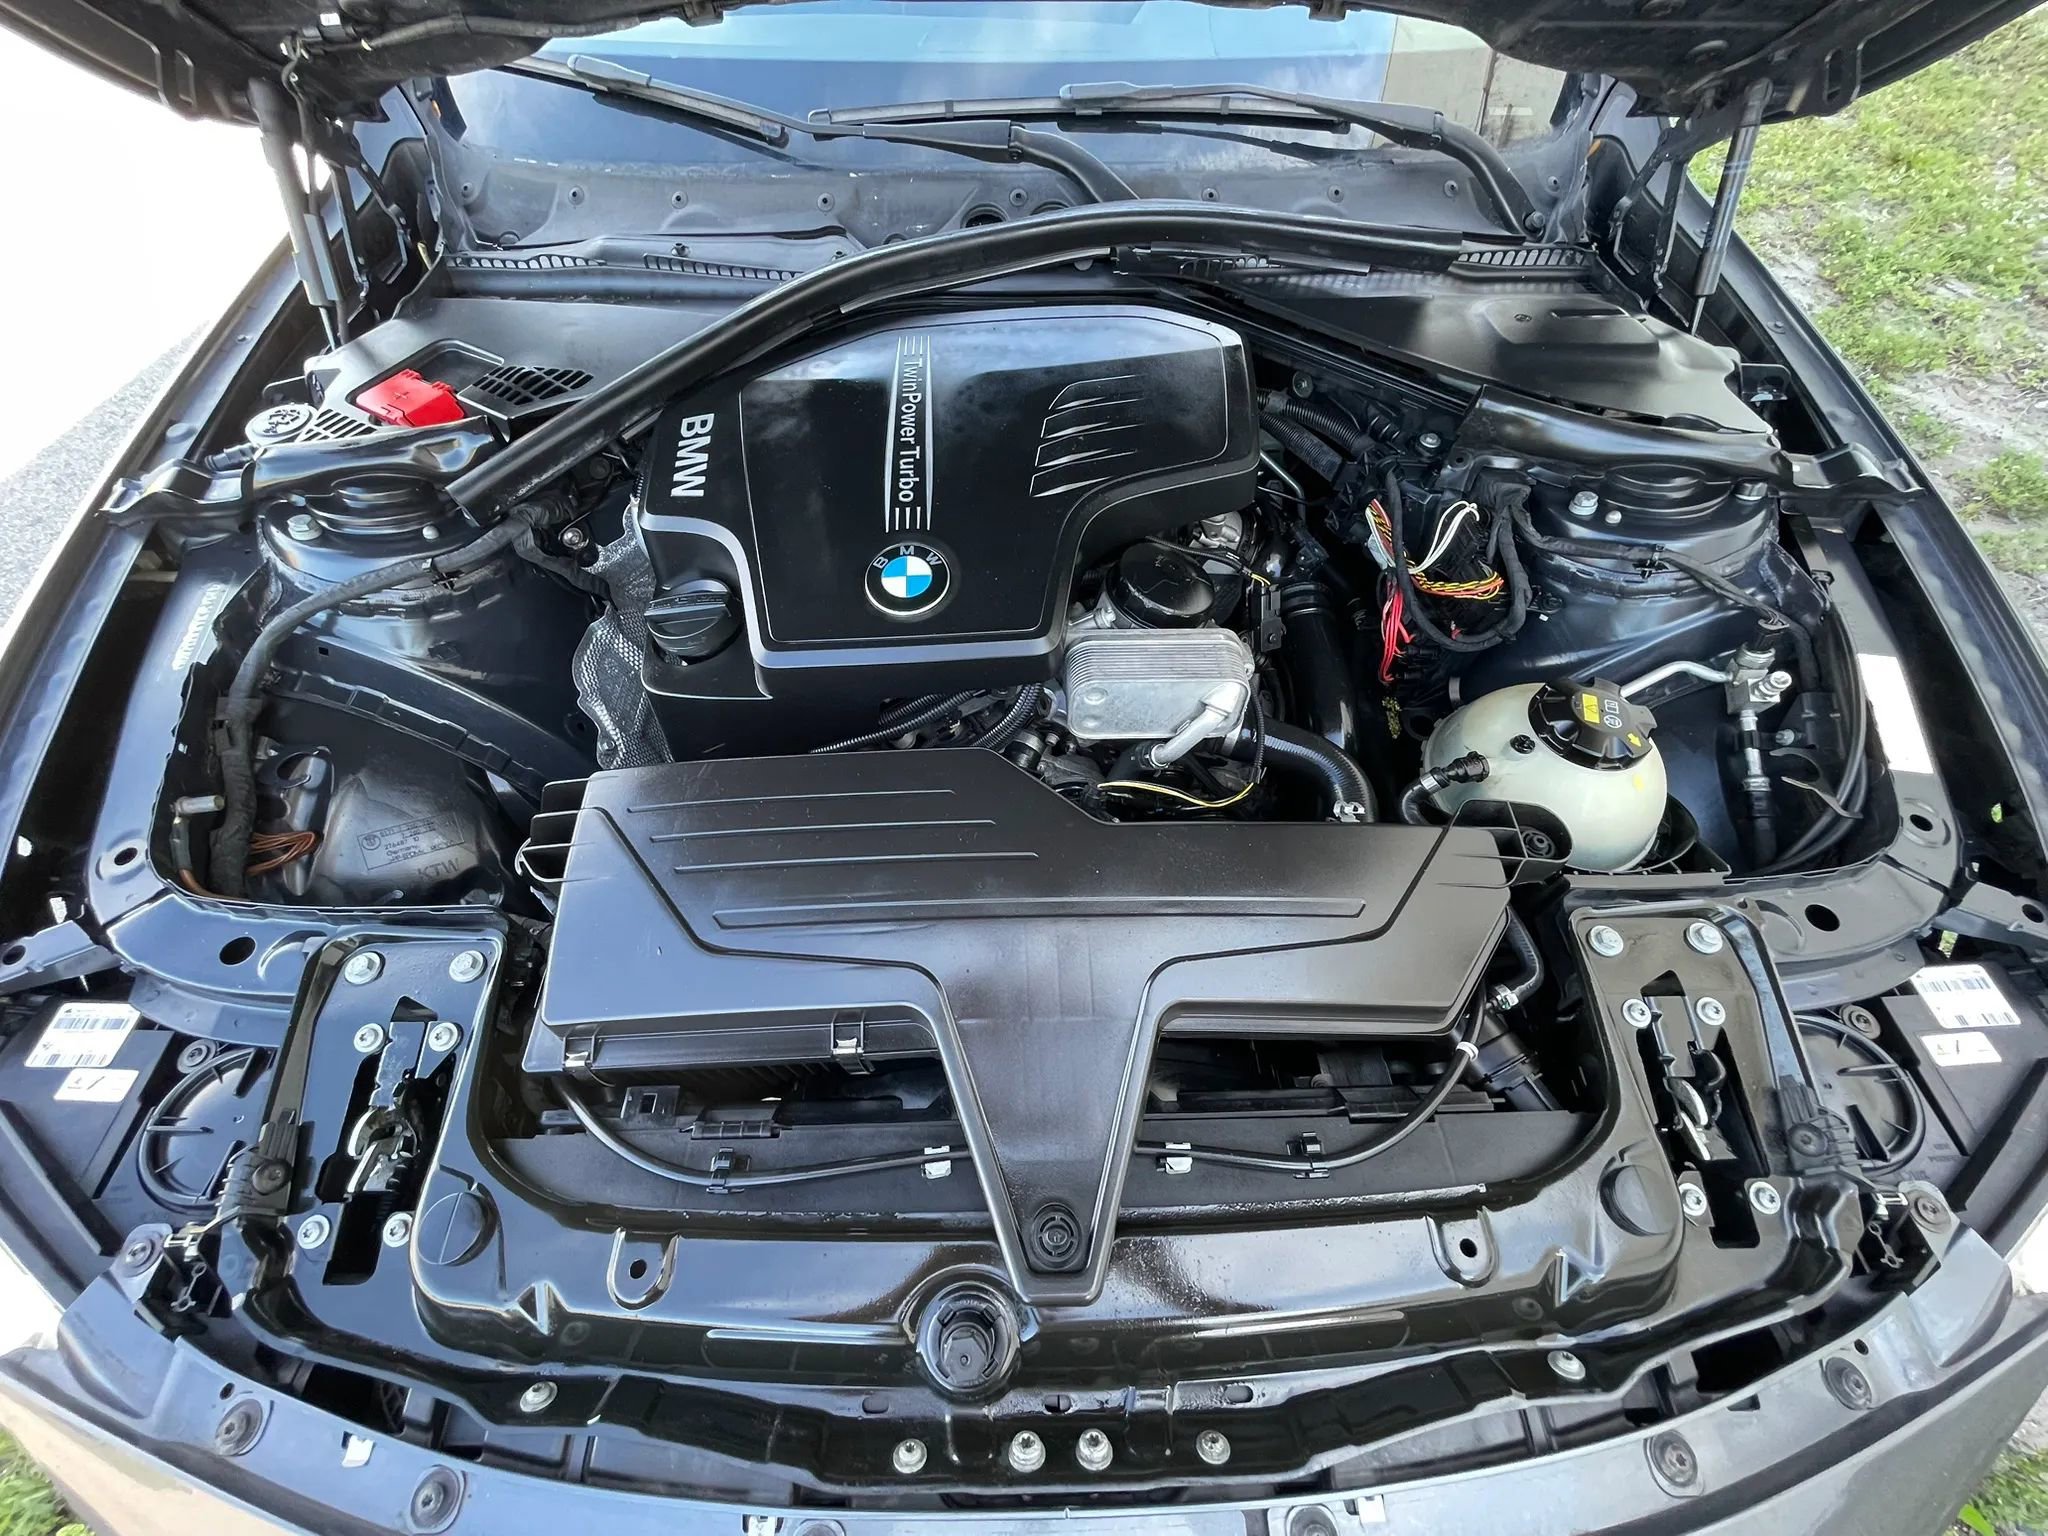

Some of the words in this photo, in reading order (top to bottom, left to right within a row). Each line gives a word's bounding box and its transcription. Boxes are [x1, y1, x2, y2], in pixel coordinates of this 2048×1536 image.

[900, 358, 923, 445] TwinPower
[670, 413, 715, 497] BMW
[898, 446, 920, 502] Turbo
[873, 545, 942, 569] BMW
